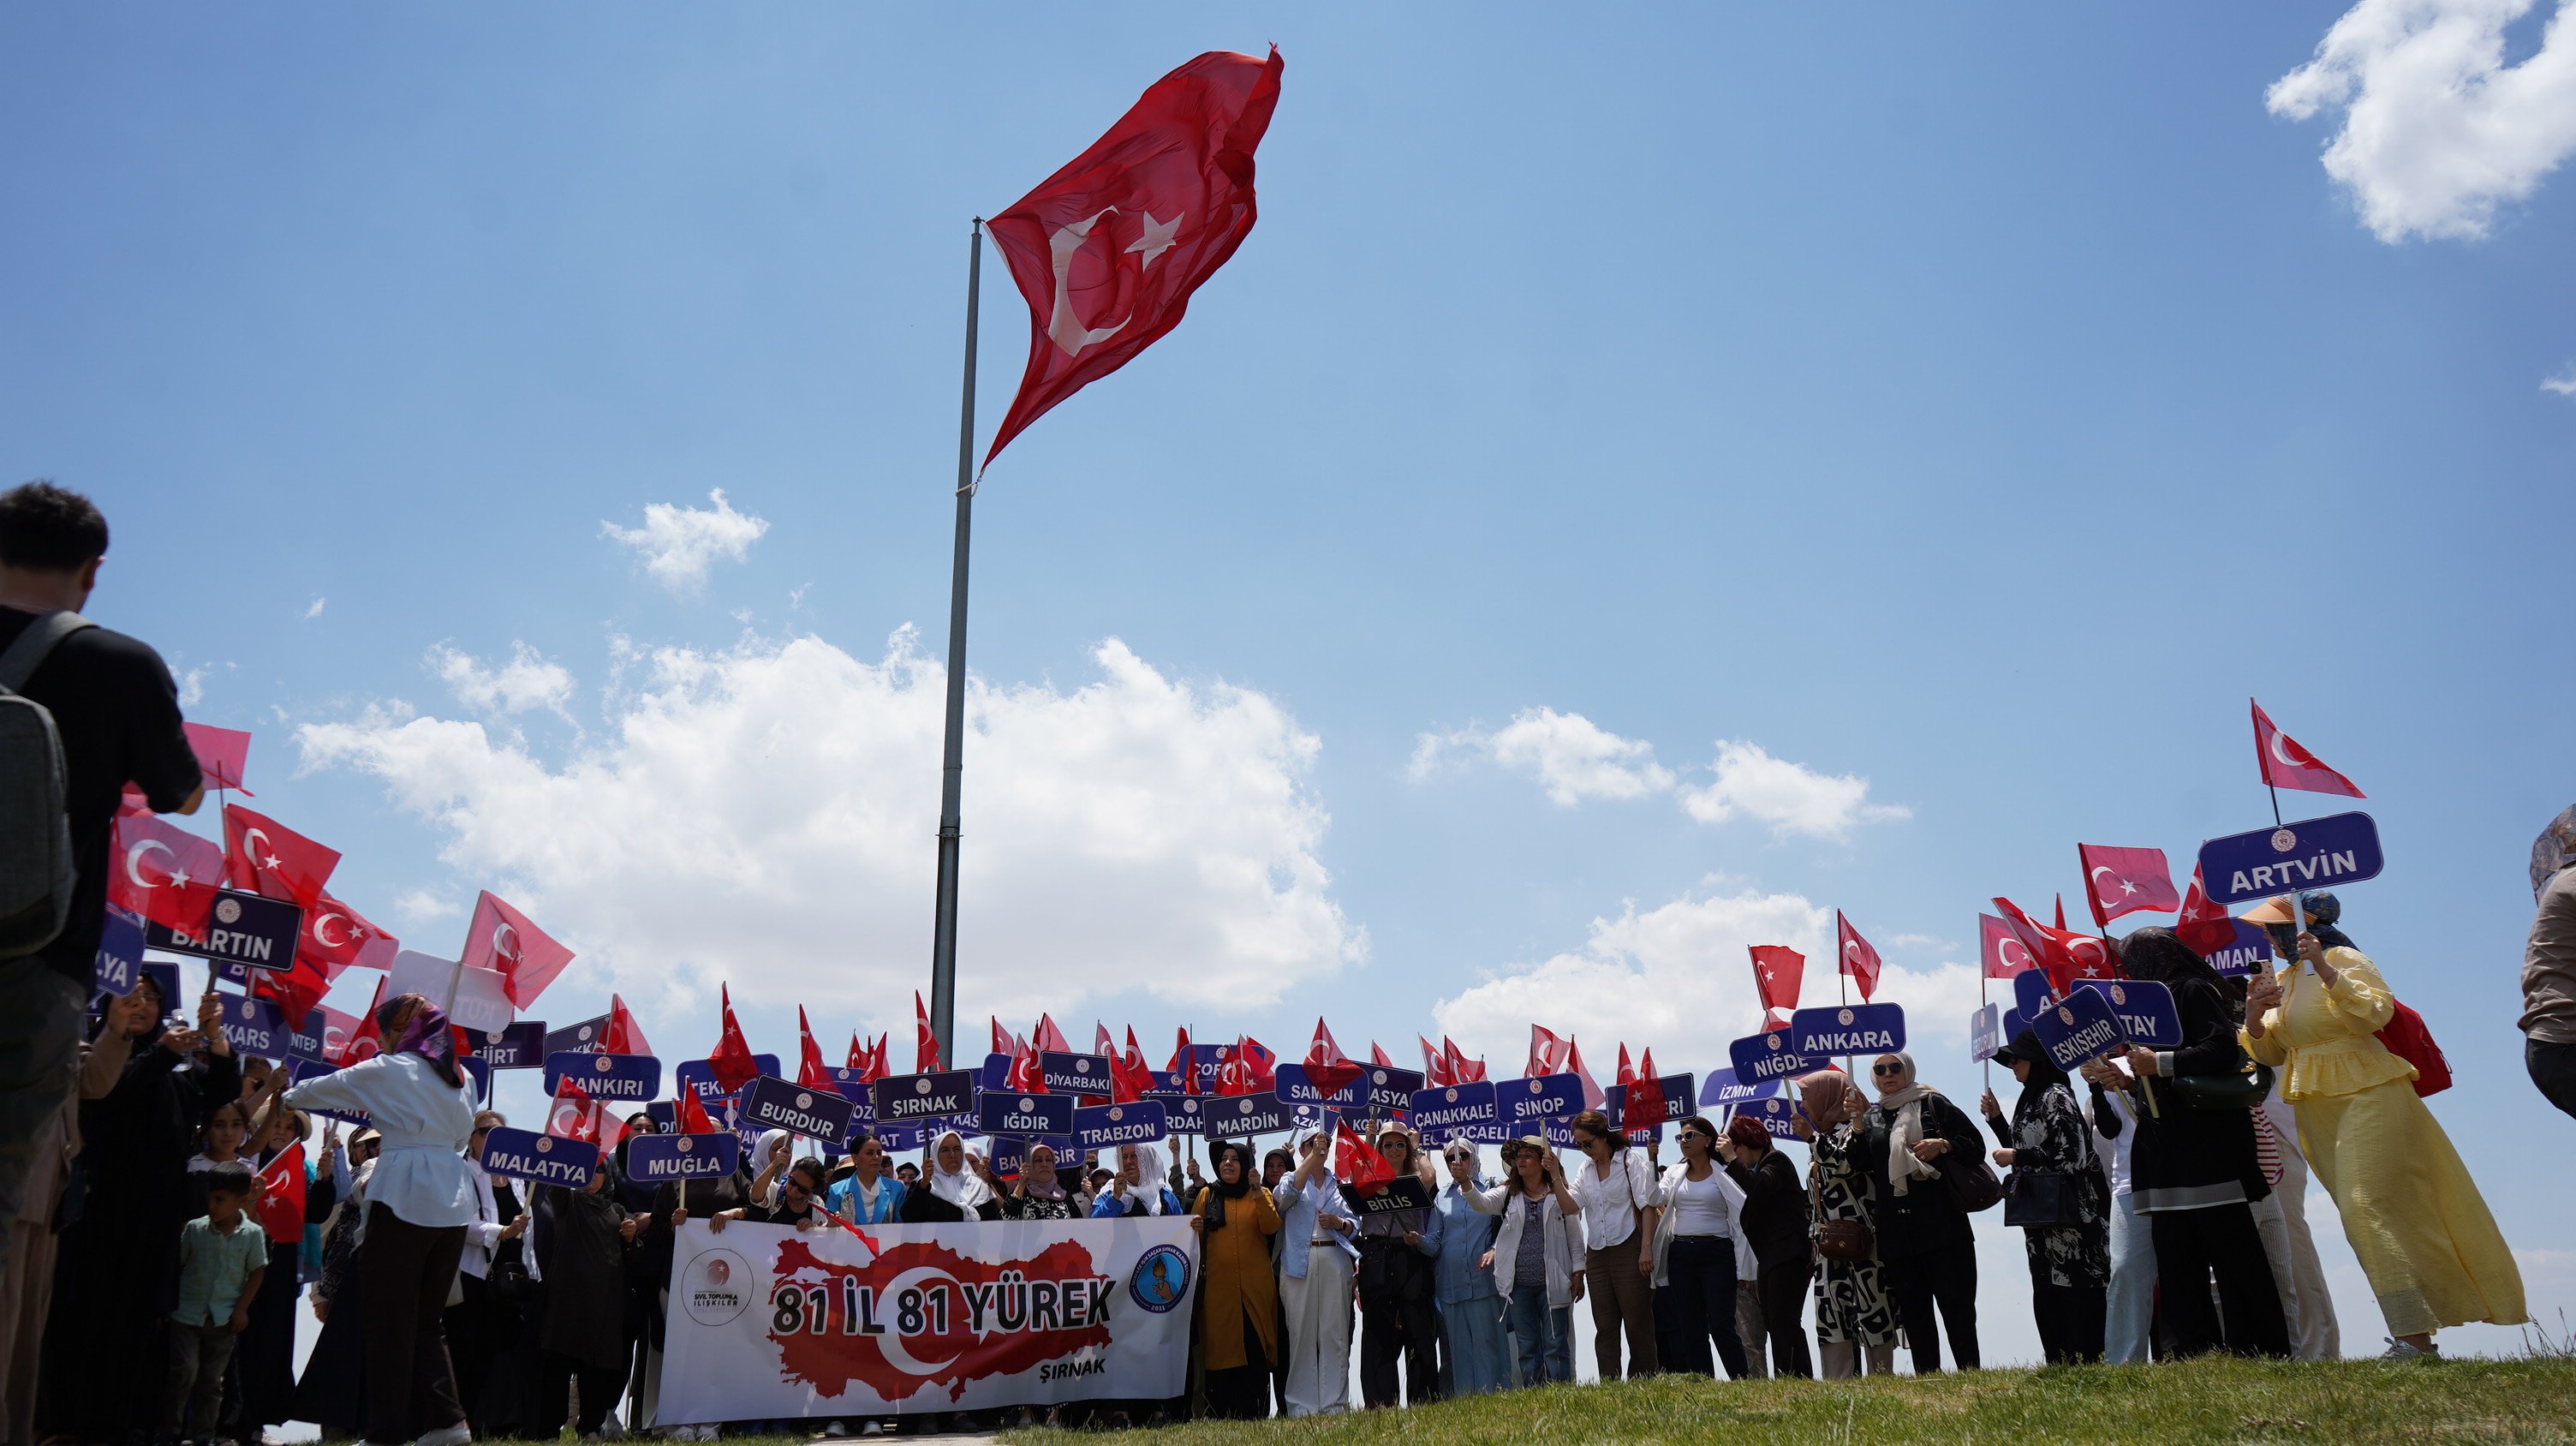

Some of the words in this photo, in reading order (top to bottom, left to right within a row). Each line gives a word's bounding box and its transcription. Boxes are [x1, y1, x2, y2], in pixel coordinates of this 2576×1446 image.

[2230, 849, 2357, 893] ARTVİN
[223, 1023, 270, 1049] KARS
[2119, 1014, 2156, 1037] TAY
[1804, 1031, 1894, 1052] ANKARA
[1972, 1031, 1996, 1055] ERZURUM
[2052, 1018, 2116, 1065] ESKİŞEHİR
[1754, 1053, 1809, 1078] NİĞDE
[1045, 1073, 1110, 1090] DİYARBAKI
[892, 1096, 957, 1117] ŞIRNAK
[1370, 1088, 1409, 1108] ASYA
[1515, 1097, 1565, 1117] SİNOP
[760, 1101, 834, 1138] BURDUR
[1004, 1112, 1049, 1130] IĞDIR
[1217, 1112, 1279, 1134] MARDİN
[1415, 1103, 1494, 1131] ÇANAKKALE
[1080, 1123, 1155, 1144] TRABZON
[1445, 1124, 1510, 1140] KOCAELİ
[489, 1151, 586, 1183] MALATYA
[648, 1154, 721, 1175] MUĞLA
[1367, 1194, 1412, 1212] BİTLİS
[772, 1287, 827, 1334] 81
[845, 1277, 885, 1334] İL
[897, 1288, 946, 1334] 81
[963, 1272, 1117, 1331] YÜREK
[1040, 1359, 1106, 1383] ŞIRNAK
